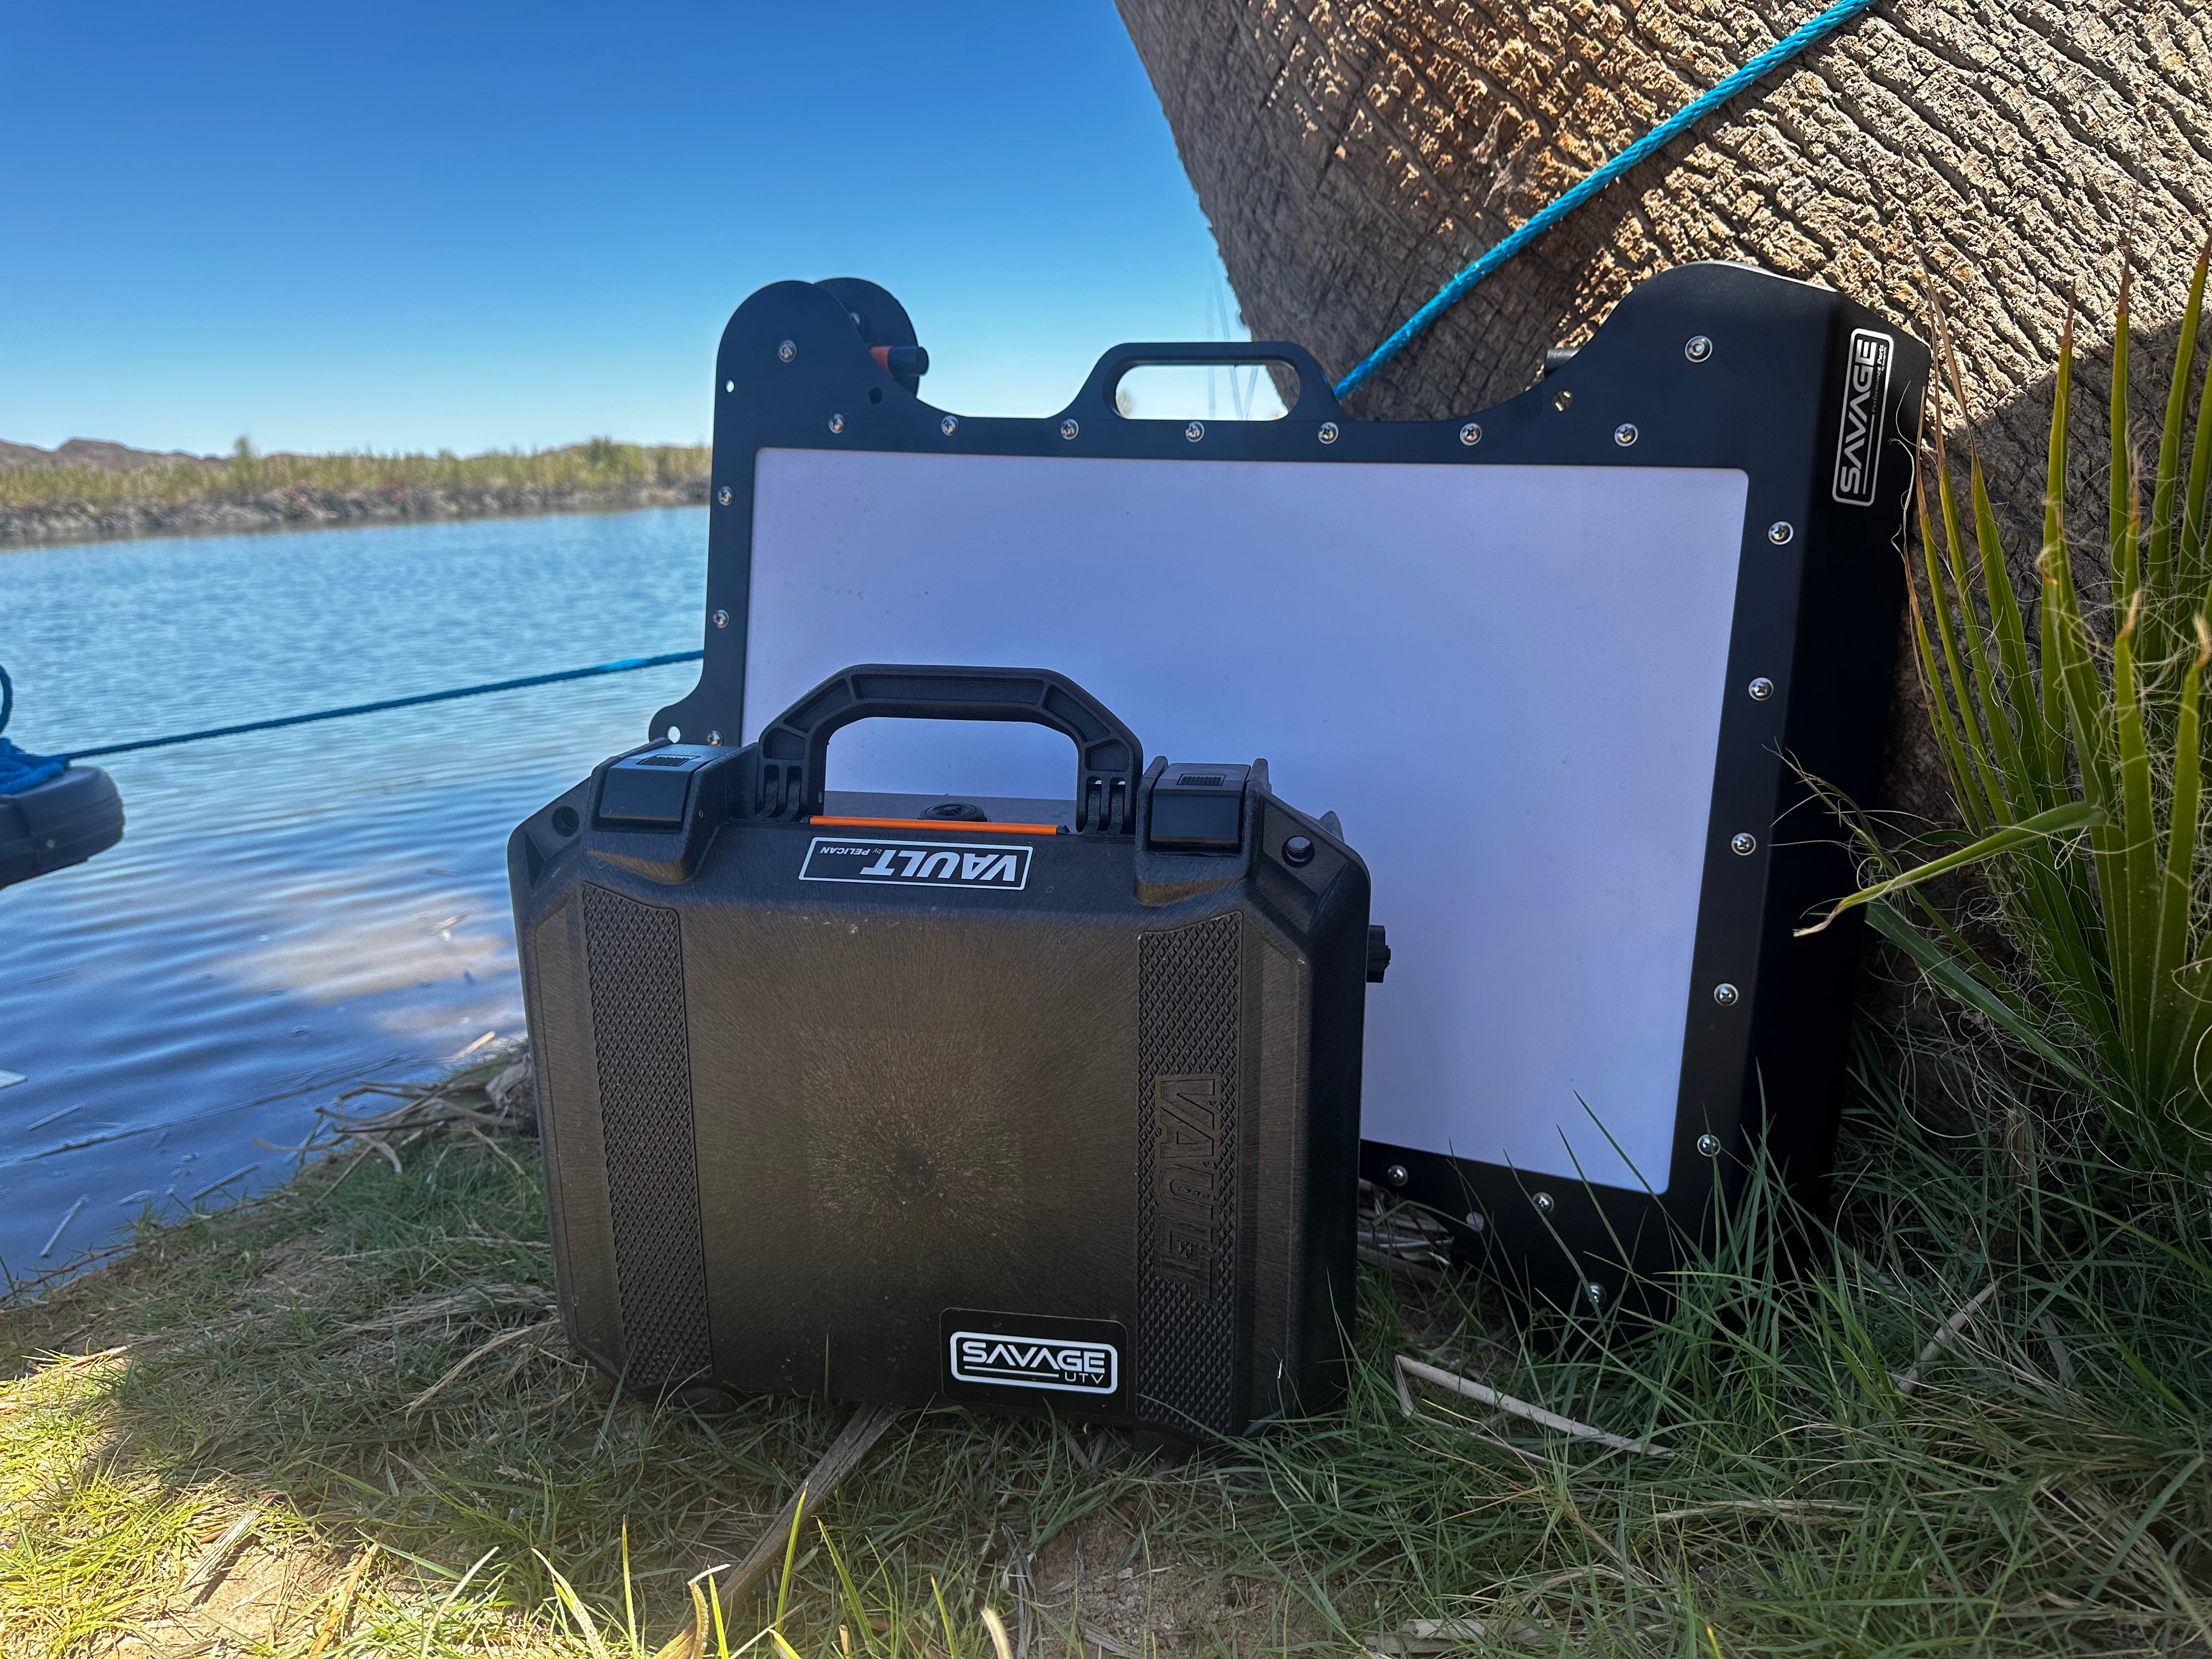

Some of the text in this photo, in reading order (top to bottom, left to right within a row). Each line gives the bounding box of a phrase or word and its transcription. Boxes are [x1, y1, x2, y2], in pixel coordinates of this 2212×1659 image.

[1871, 366, 1881, 413] Performance
[1839, 338, 1877, 494] SAVAGE
[820, 846, 871, 856] PELICAN
[859, 849, 1018, 882] VAULT
[1159, 1079, 1215, 1301] VAULT
[962, 1340, 1105, 1374] SAVAGE
[1064, 1372, 1104, 1384] UTV
